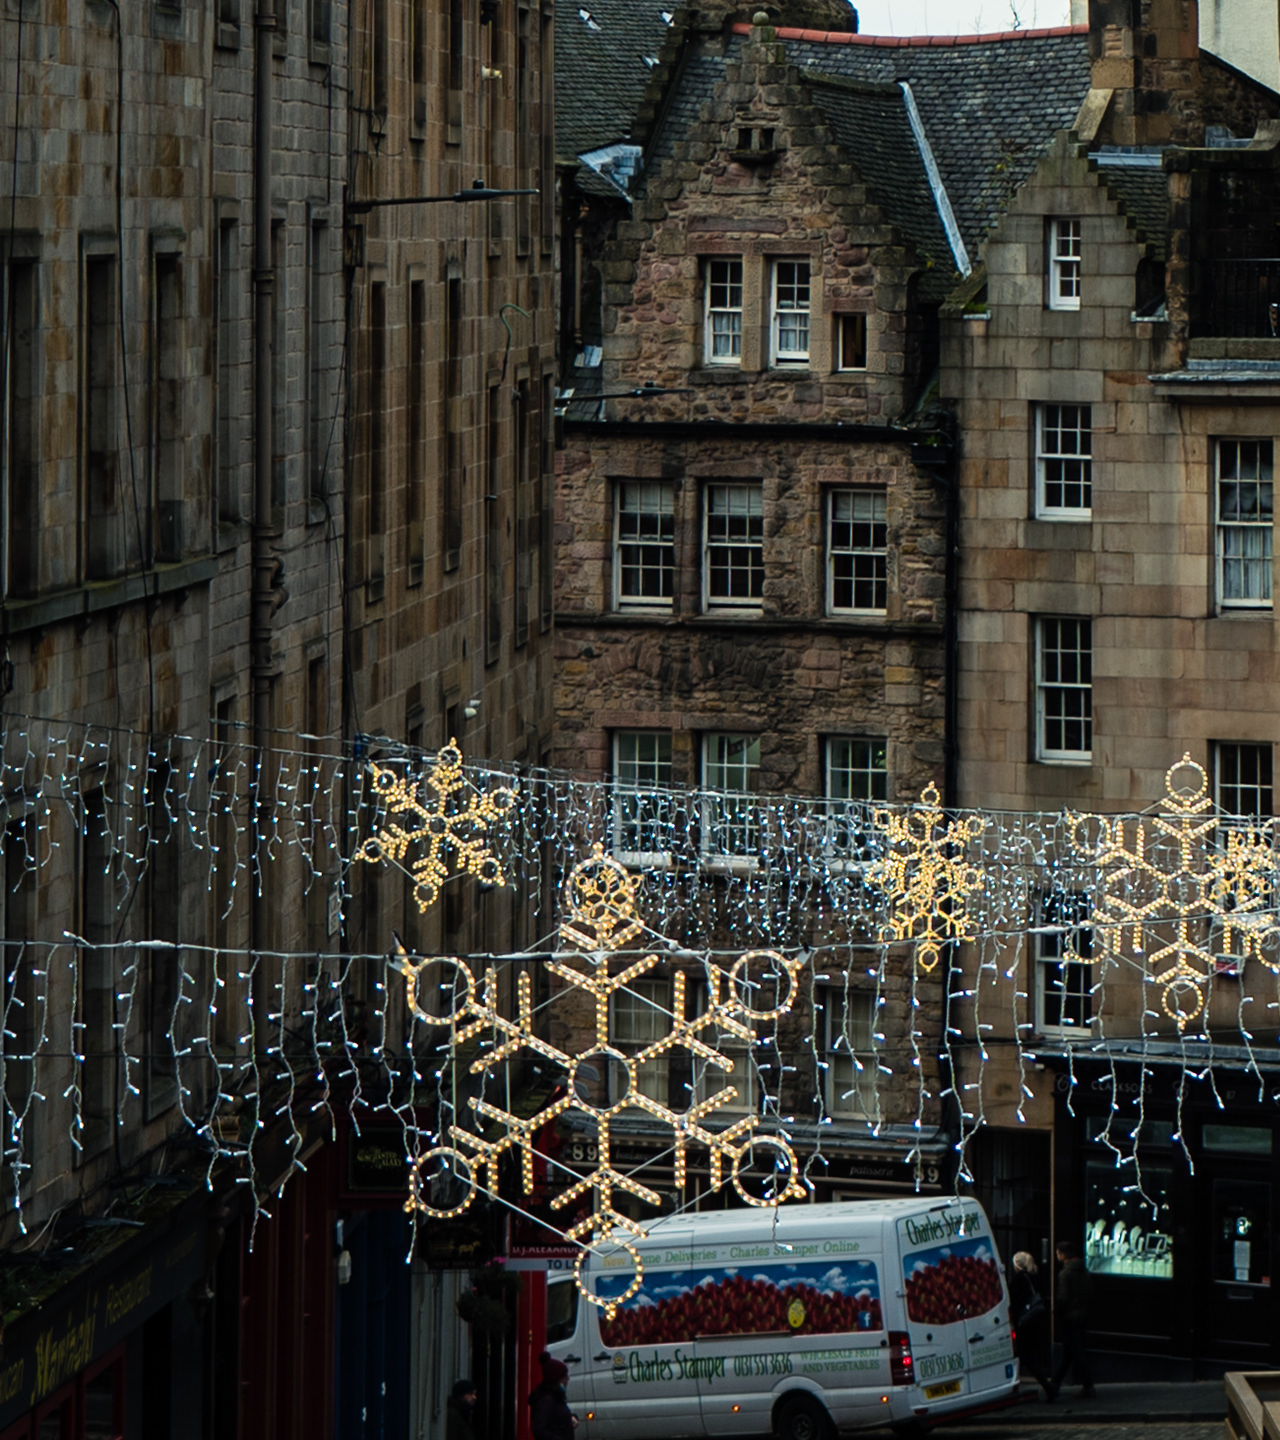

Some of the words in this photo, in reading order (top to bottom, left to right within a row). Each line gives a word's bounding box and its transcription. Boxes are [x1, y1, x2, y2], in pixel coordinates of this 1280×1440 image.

[572, 1143, 598, 1161] 89
[912, 1166, 939, 1183] 89
[906, 1216, 944, 1245] Charles
[665, 1248, 717, 1262] Deliveries
[730, 1243, 769, 1259] Charles
[824, 1239, 859, 1252] Online
[547, 1259, 562, 1269] TO
[629, 1350, 673, 1382] Charles
[674, 1348, 726, 1384] Stamper
[803, 1363, 819, 1373] AND
